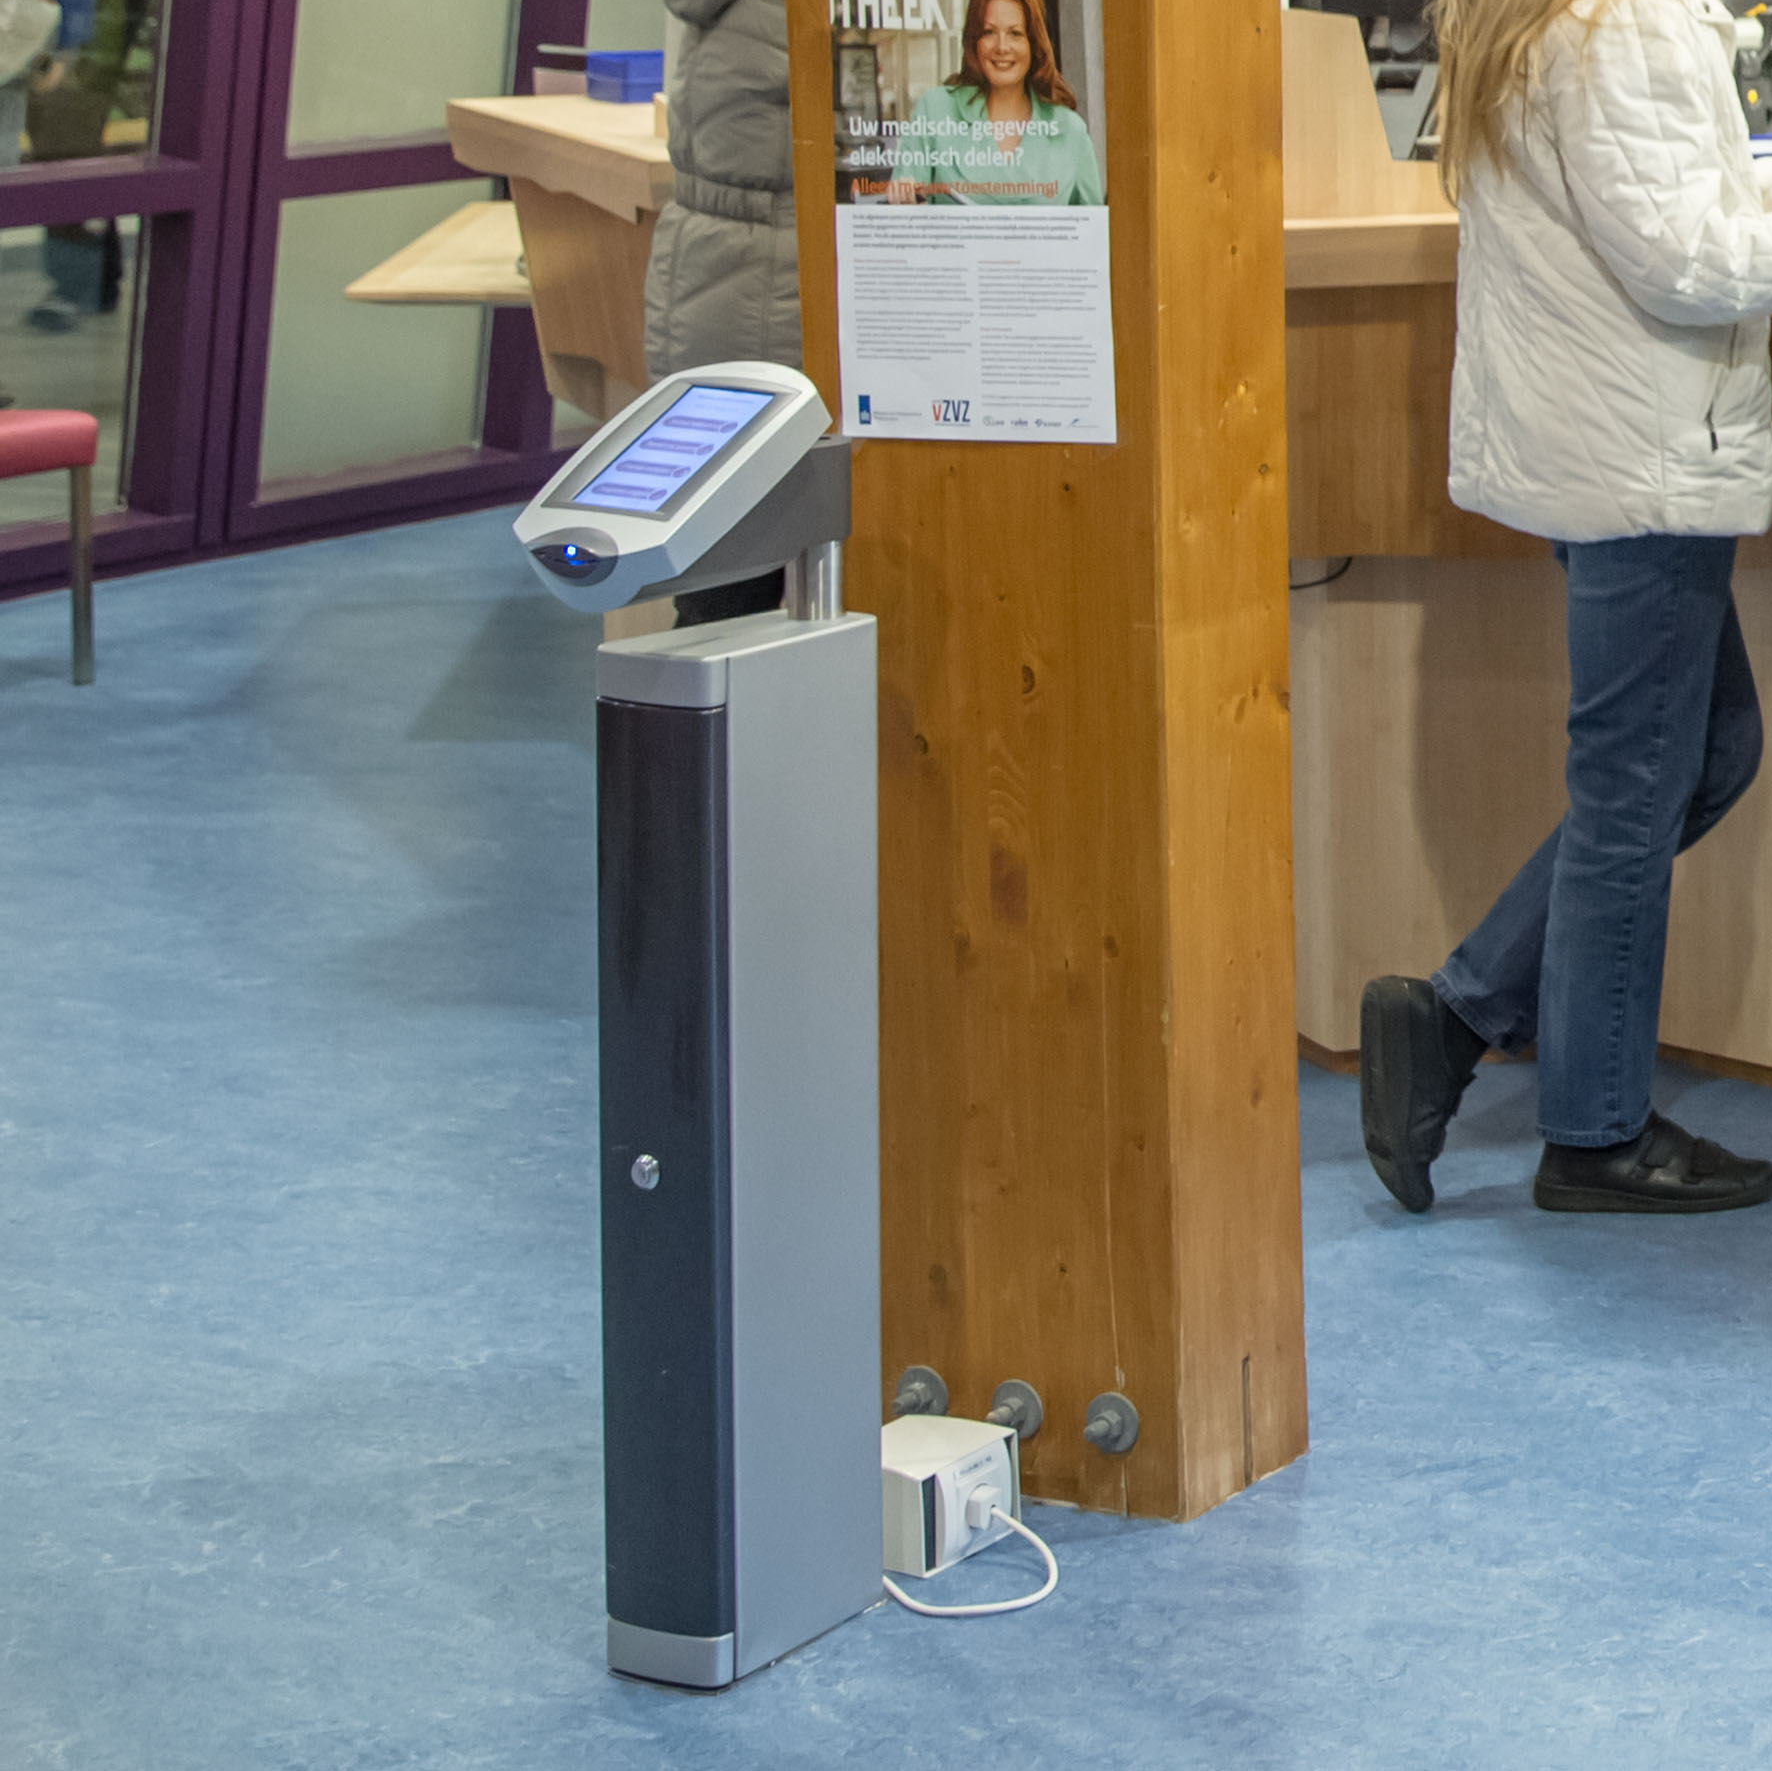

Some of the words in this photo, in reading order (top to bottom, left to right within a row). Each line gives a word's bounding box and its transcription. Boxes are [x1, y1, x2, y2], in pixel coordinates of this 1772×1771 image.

[849, 117, 879, 136] Uw
[882, 116, 969, 137] medische
[972, 120, 1060, 142] gegevens
[849, 146, 960, 167] elektronisch
[964, 148, 1024, 167] delen?
